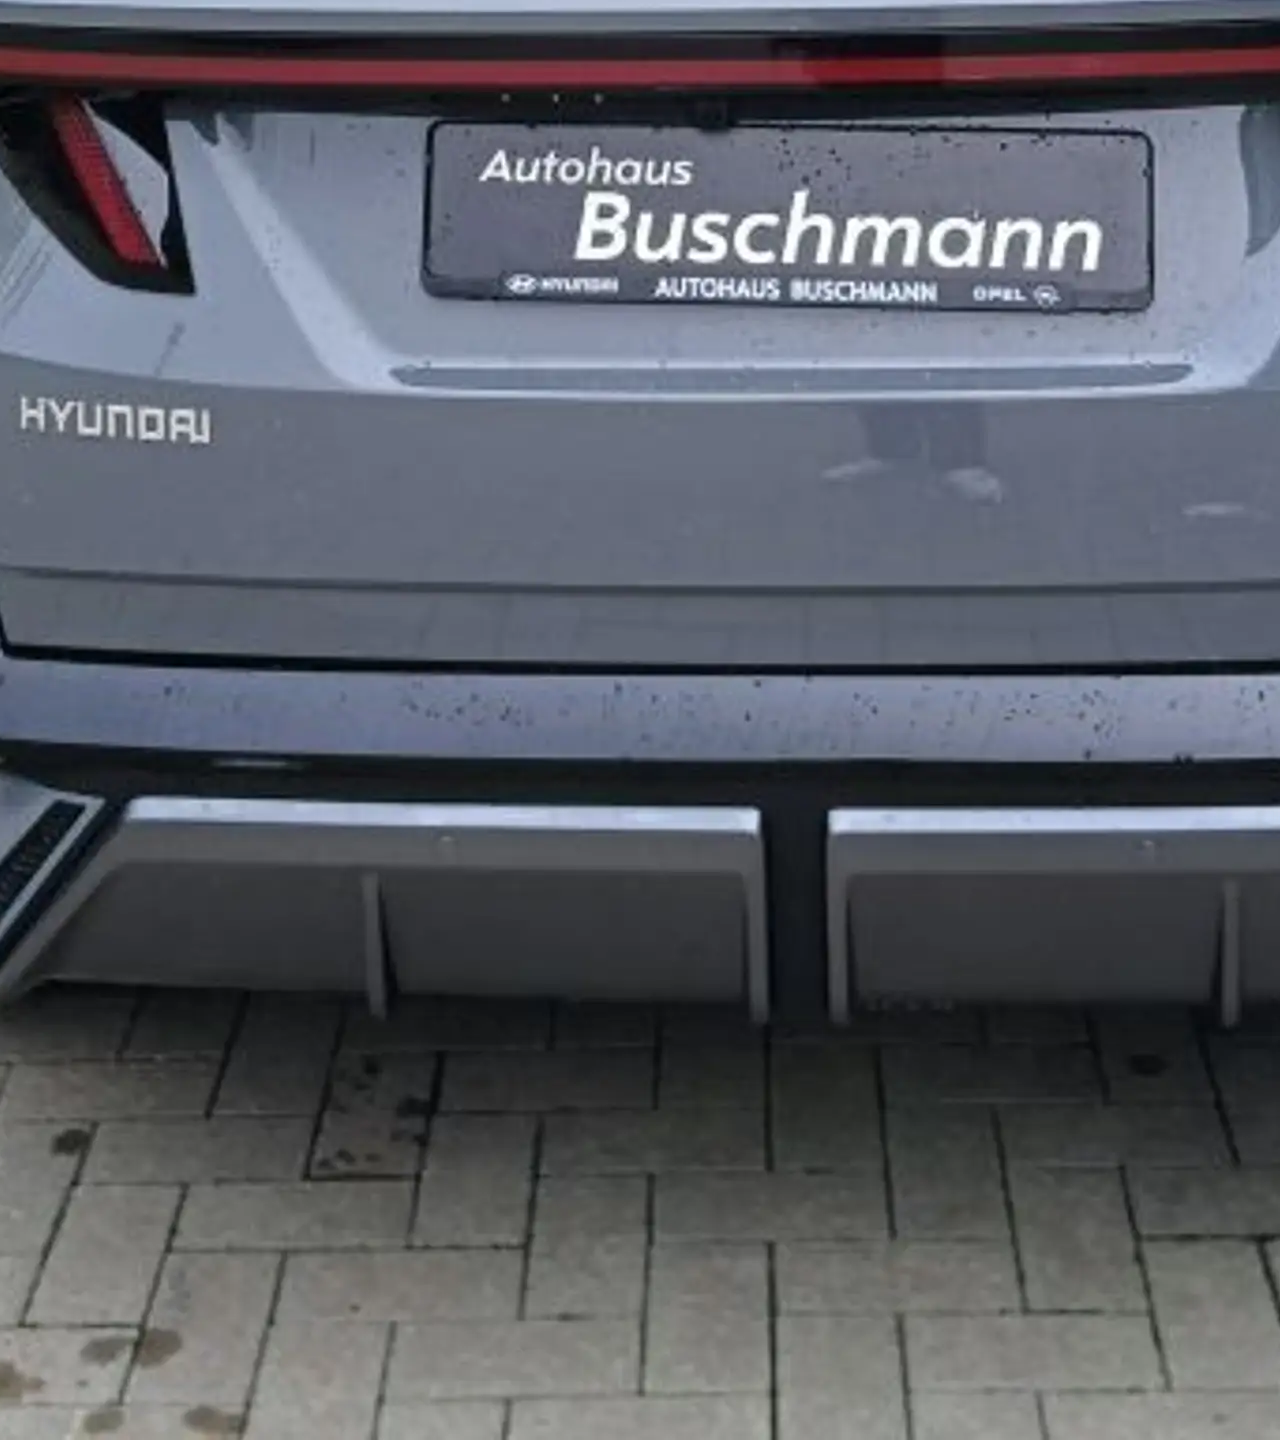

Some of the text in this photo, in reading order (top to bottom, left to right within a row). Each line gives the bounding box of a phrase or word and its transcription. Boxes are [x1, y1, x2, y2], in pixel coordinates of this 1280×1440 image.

[478, 145, 695, 187] Autohaus
[573, 189, 1105, 272] Buschmann
[539, 276, 619, 295] HYUNDAI
[654, 276, 938, 303] AUTOHAUS BUSCHMANN
[972, 285, 1028, 301] OPEL
[20, 395, 211, 444] HYUNDAI
